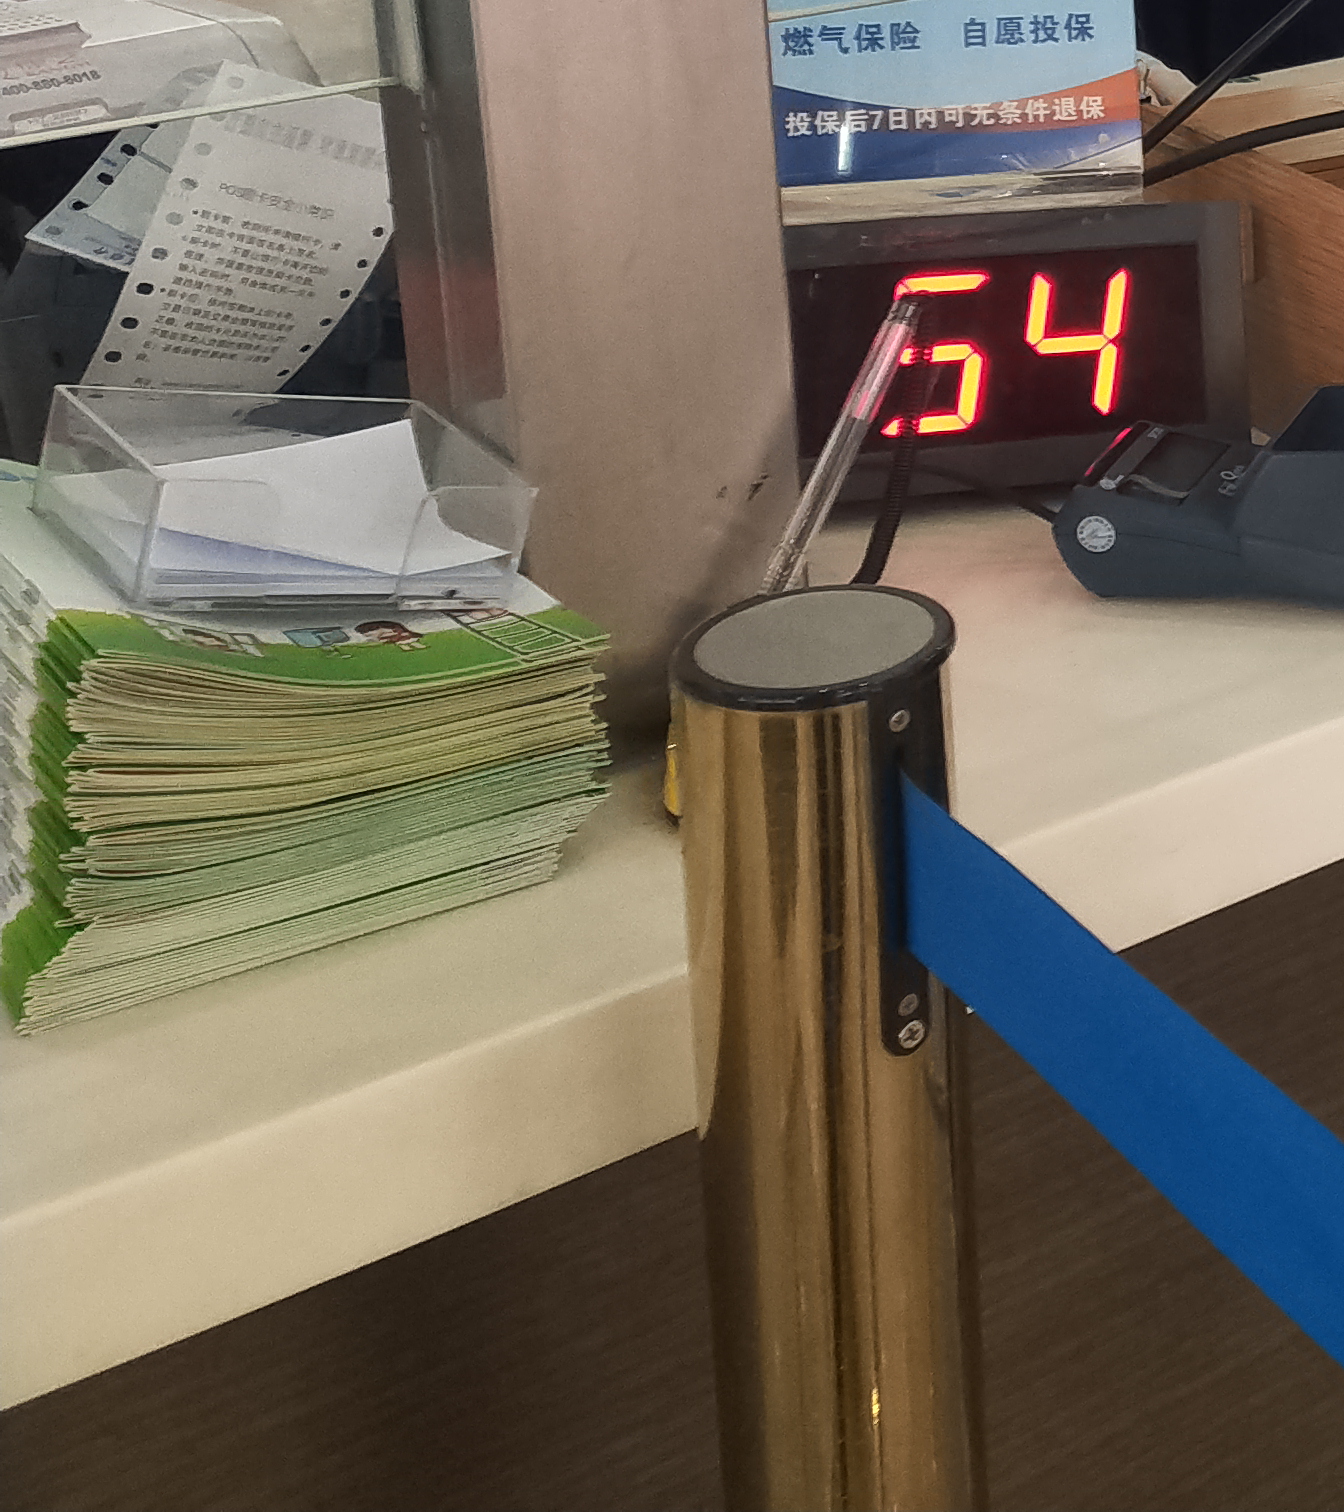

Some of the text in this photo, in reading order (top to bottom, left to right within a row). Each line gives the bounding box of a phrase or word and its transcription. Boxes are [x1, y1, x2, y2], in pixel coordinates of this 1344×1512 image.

[780, 11, 1096, 57] 燃气保险 自愿投保
[876, 266, 1131, 441] 54
